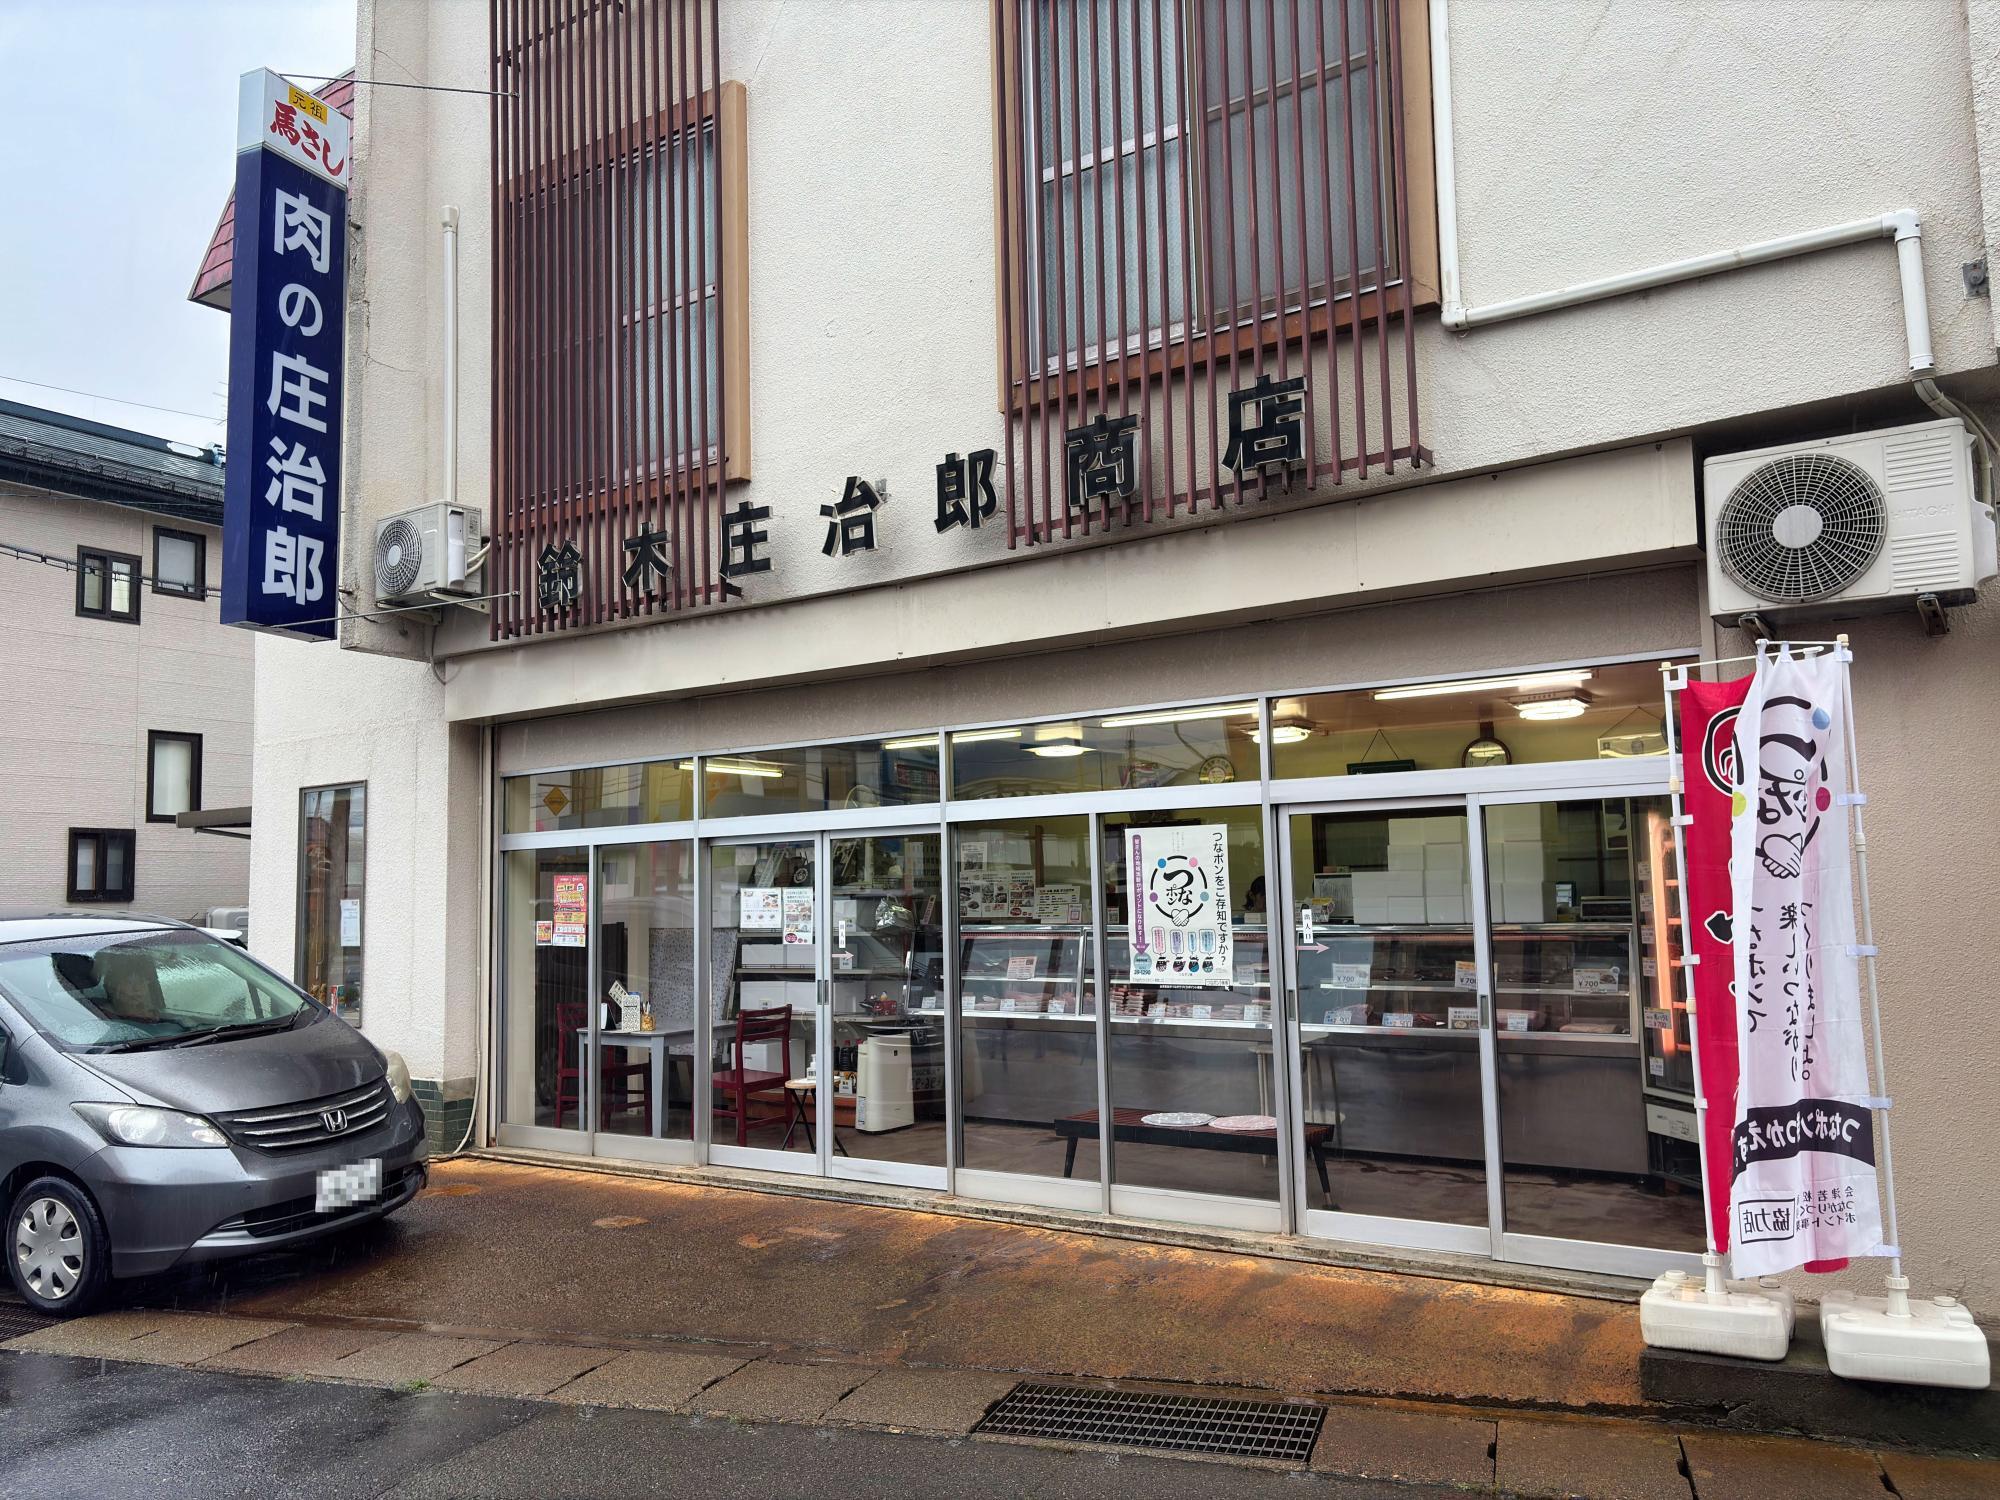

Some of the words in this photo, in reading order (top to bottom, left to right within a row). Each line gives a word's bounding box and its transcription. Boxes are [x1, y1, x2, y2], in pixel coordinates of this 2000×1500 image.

[270, 99, 345, 177] 馬さし
[291, 91, 324, 121] 元祖
[261, 187, 332, 606] 肉の庄治郎
[537, 374, 1307, 609] 鈴木庄治郎商店
[1891, 502, 1956, 521] HITACHI
